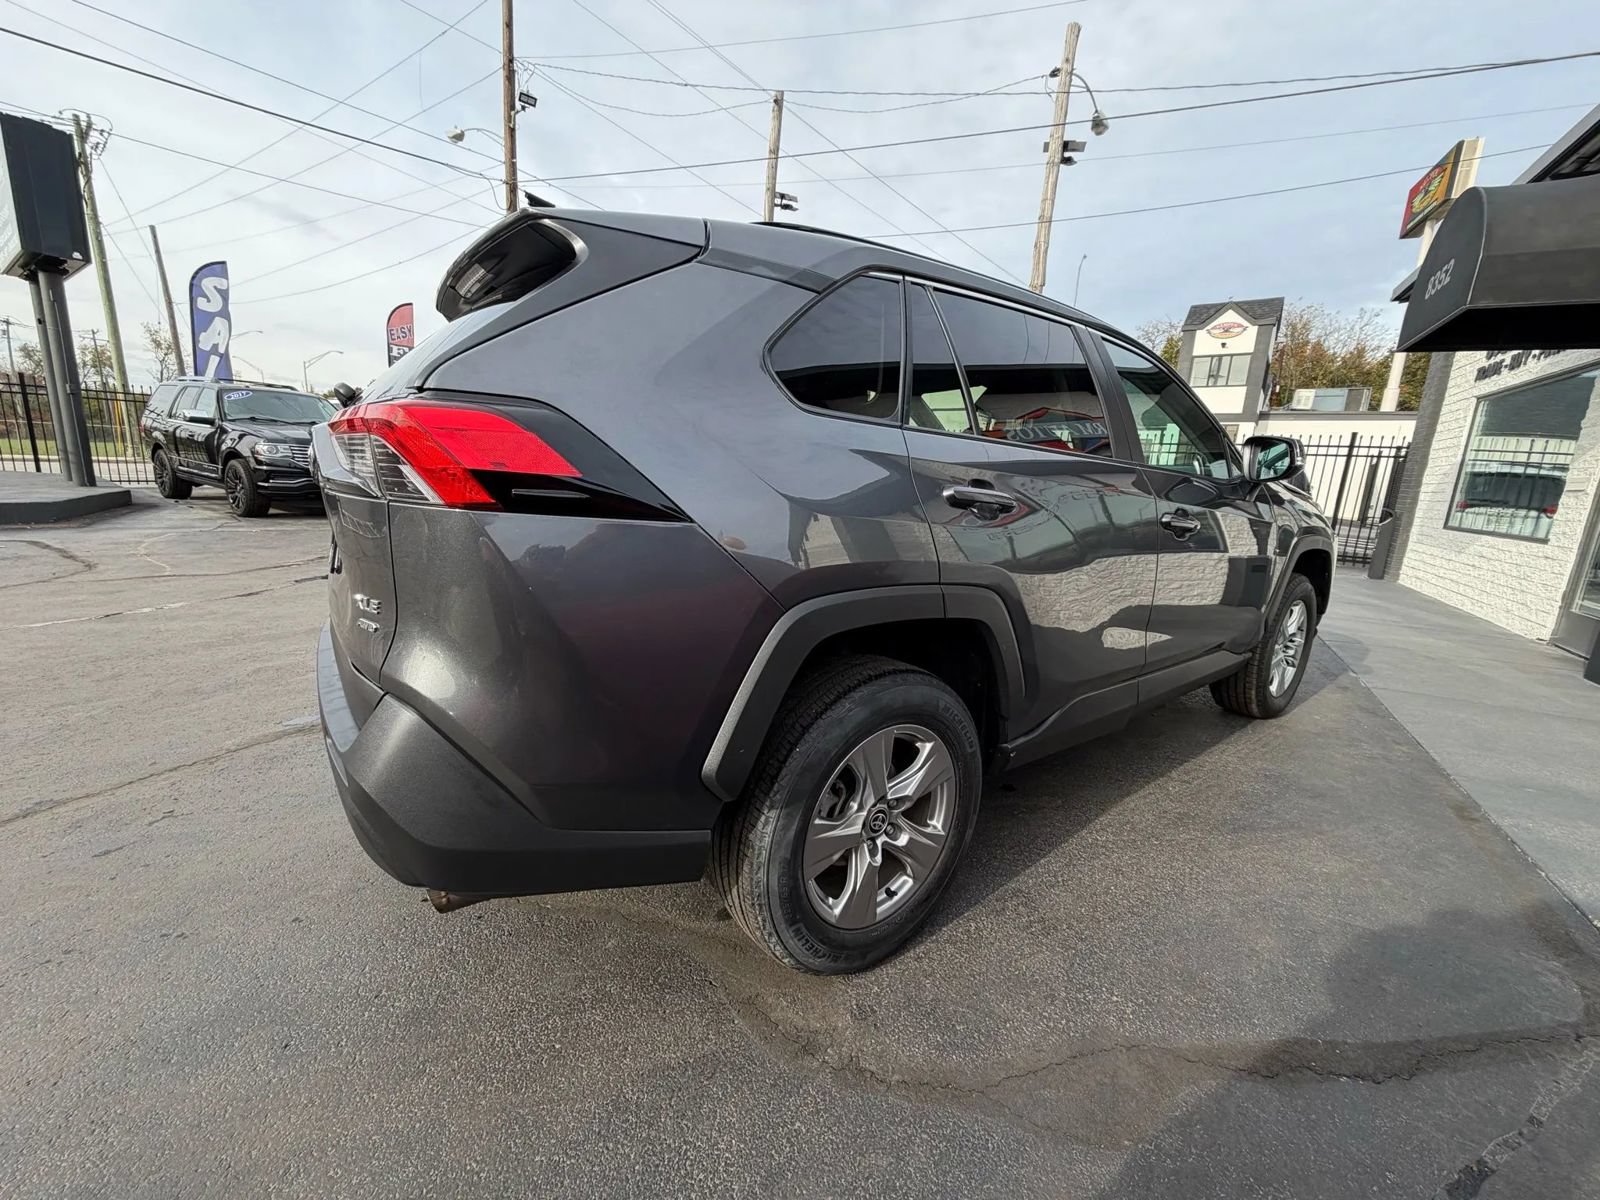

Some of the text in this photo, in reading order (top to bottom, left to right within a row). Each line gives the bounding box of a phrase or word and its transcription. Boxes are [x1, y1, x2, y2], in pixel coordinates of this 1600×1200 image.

[1425, 258, 1455, 300] 8352
[389, 325, 412, 341] EASY
[354, 594, 381, 615] XLE
[791, 925, 847, 964] MICHELIN
